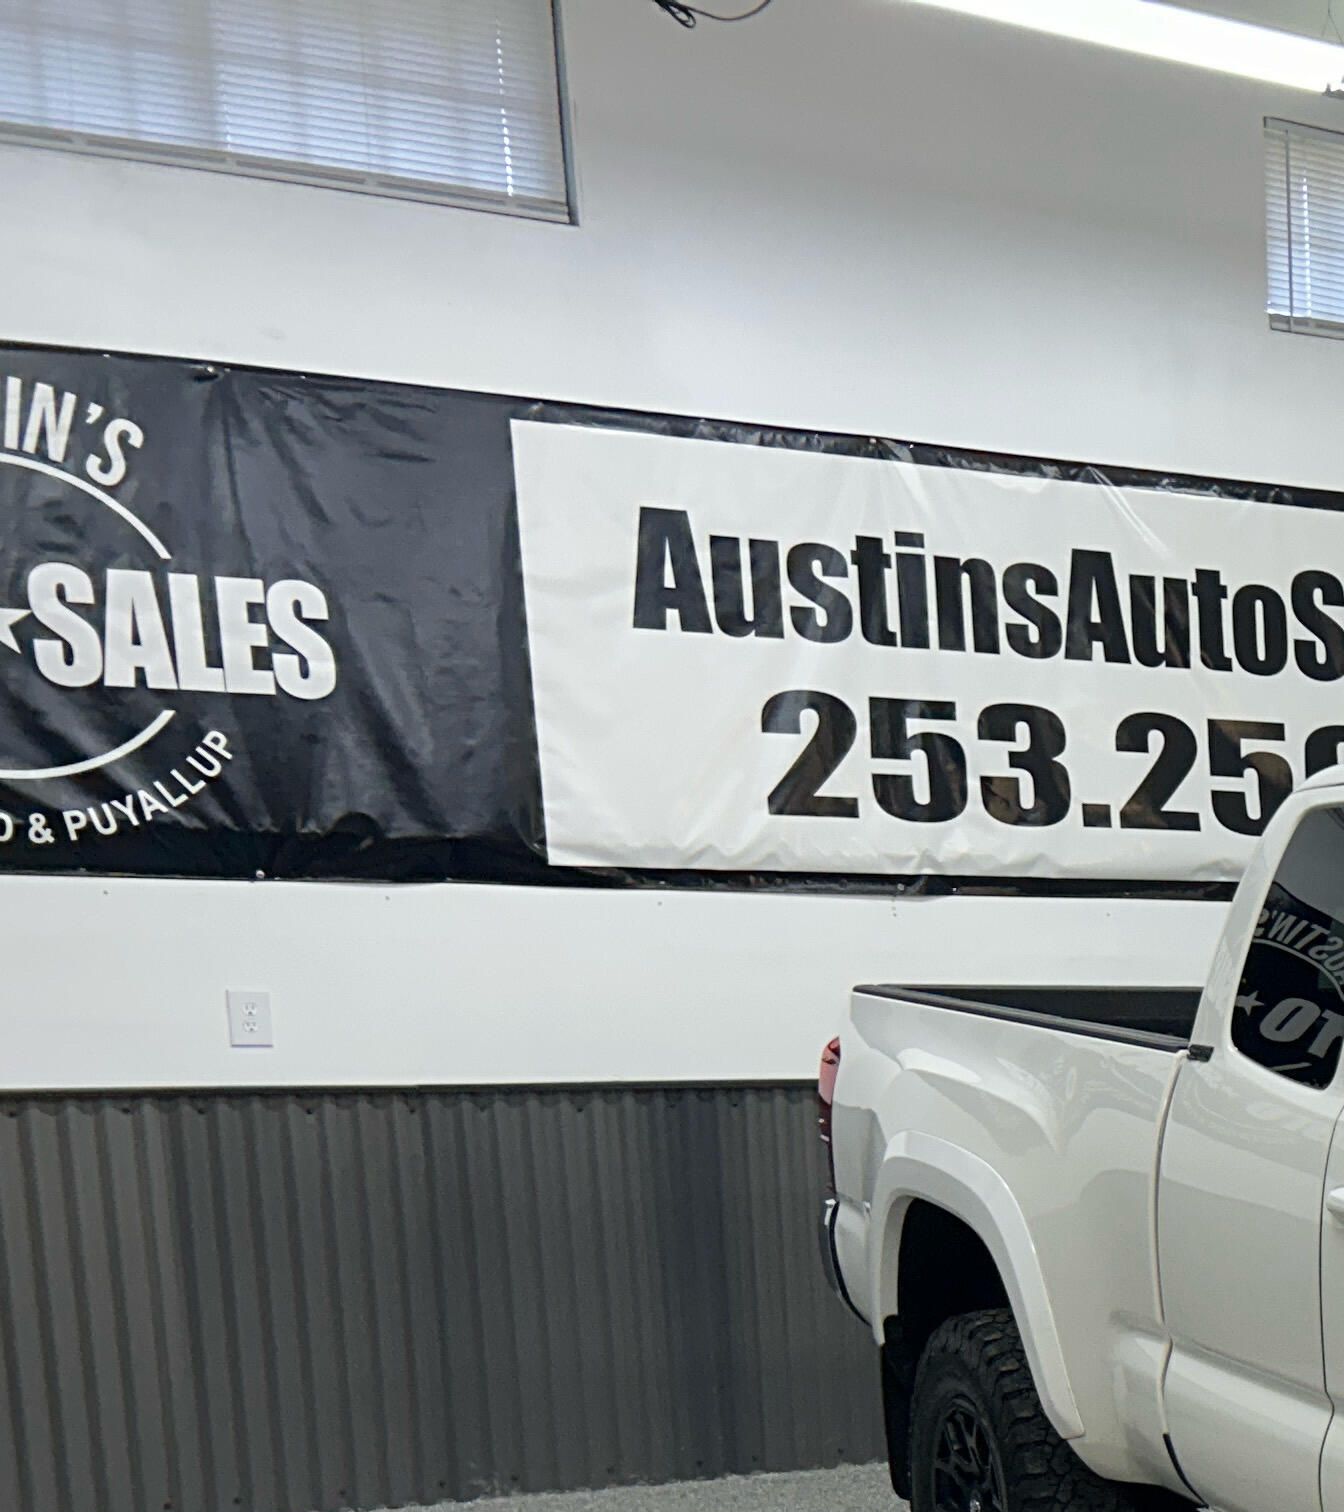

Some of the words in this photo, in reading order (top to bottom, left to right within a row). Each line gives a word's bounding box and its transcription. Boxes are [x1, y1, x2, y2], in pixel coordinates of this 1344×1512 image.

[3, 375, 145, 487] IN'S
[26, 562, 337, 700] SALES
[28, 812, 55, 844] &
[62, 730, 233, 842] PUYALLUP
